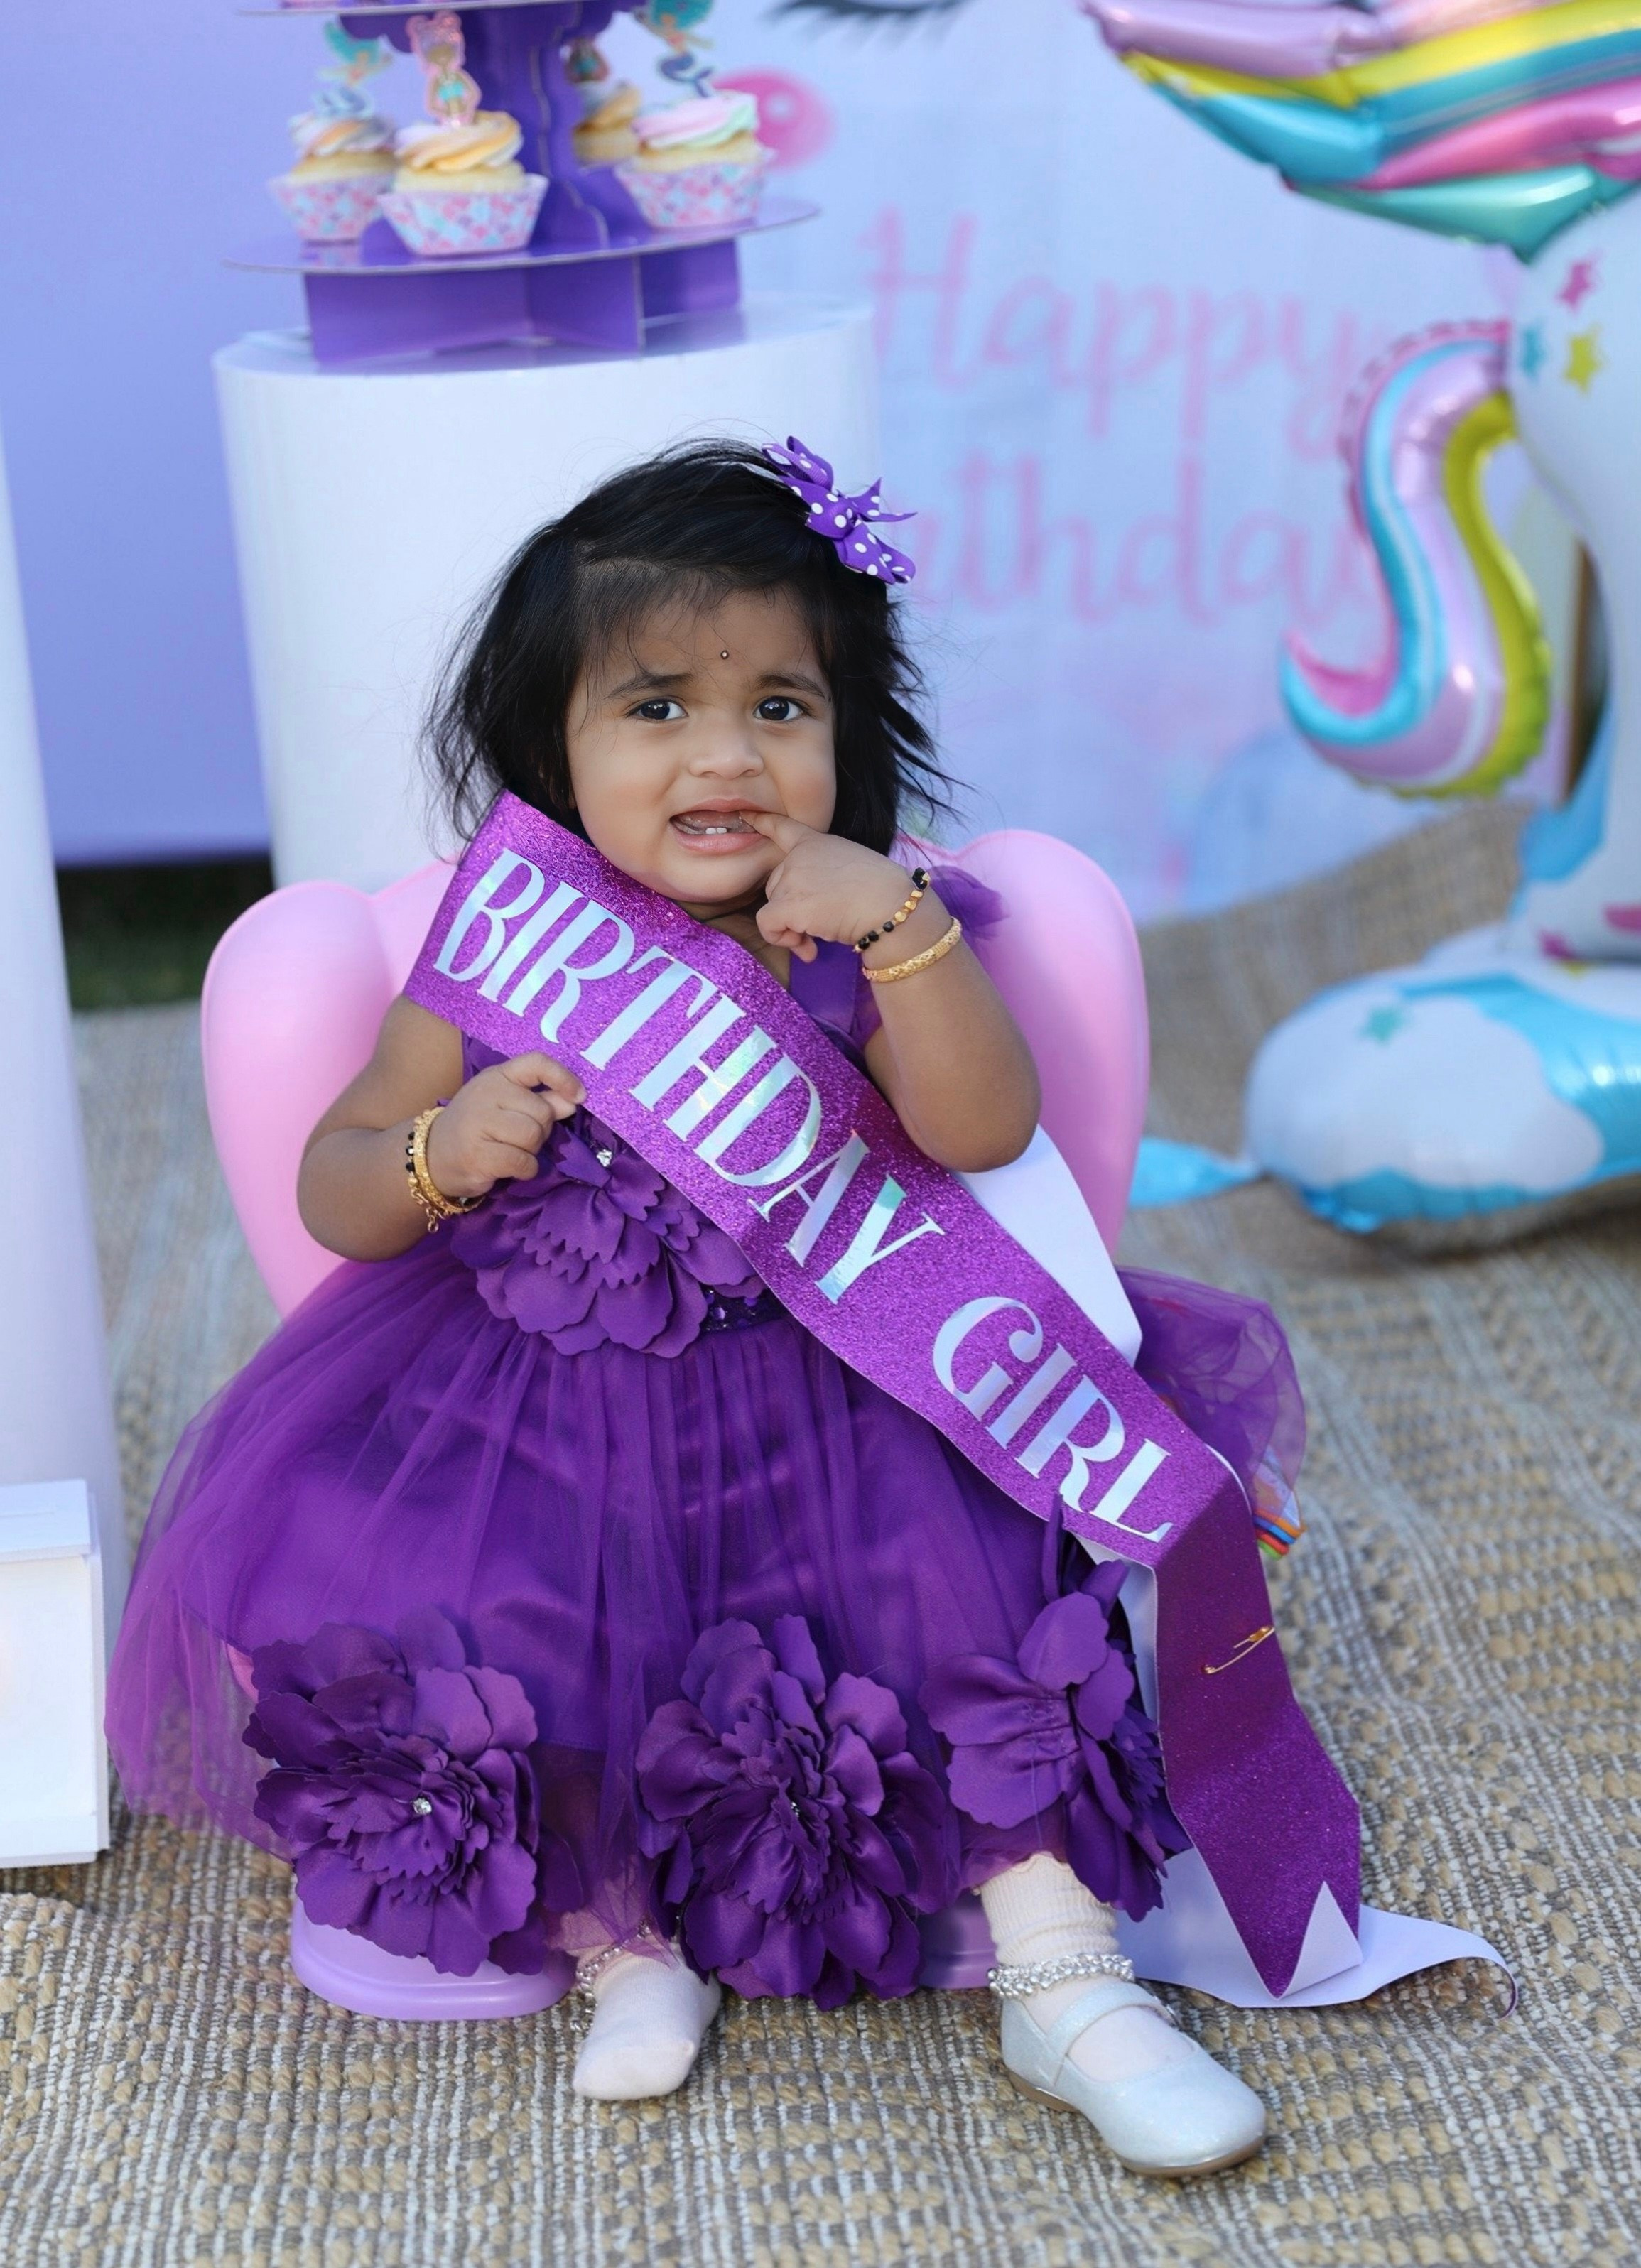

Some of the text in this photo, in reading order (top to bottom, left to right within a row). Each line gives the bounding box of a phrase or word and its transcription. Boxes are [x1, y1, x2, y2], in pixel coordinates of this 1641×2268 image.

[855, 201, 1364, 463] Happy
[433, 847, 1174, 1543] BIRTHDAY GIRL
